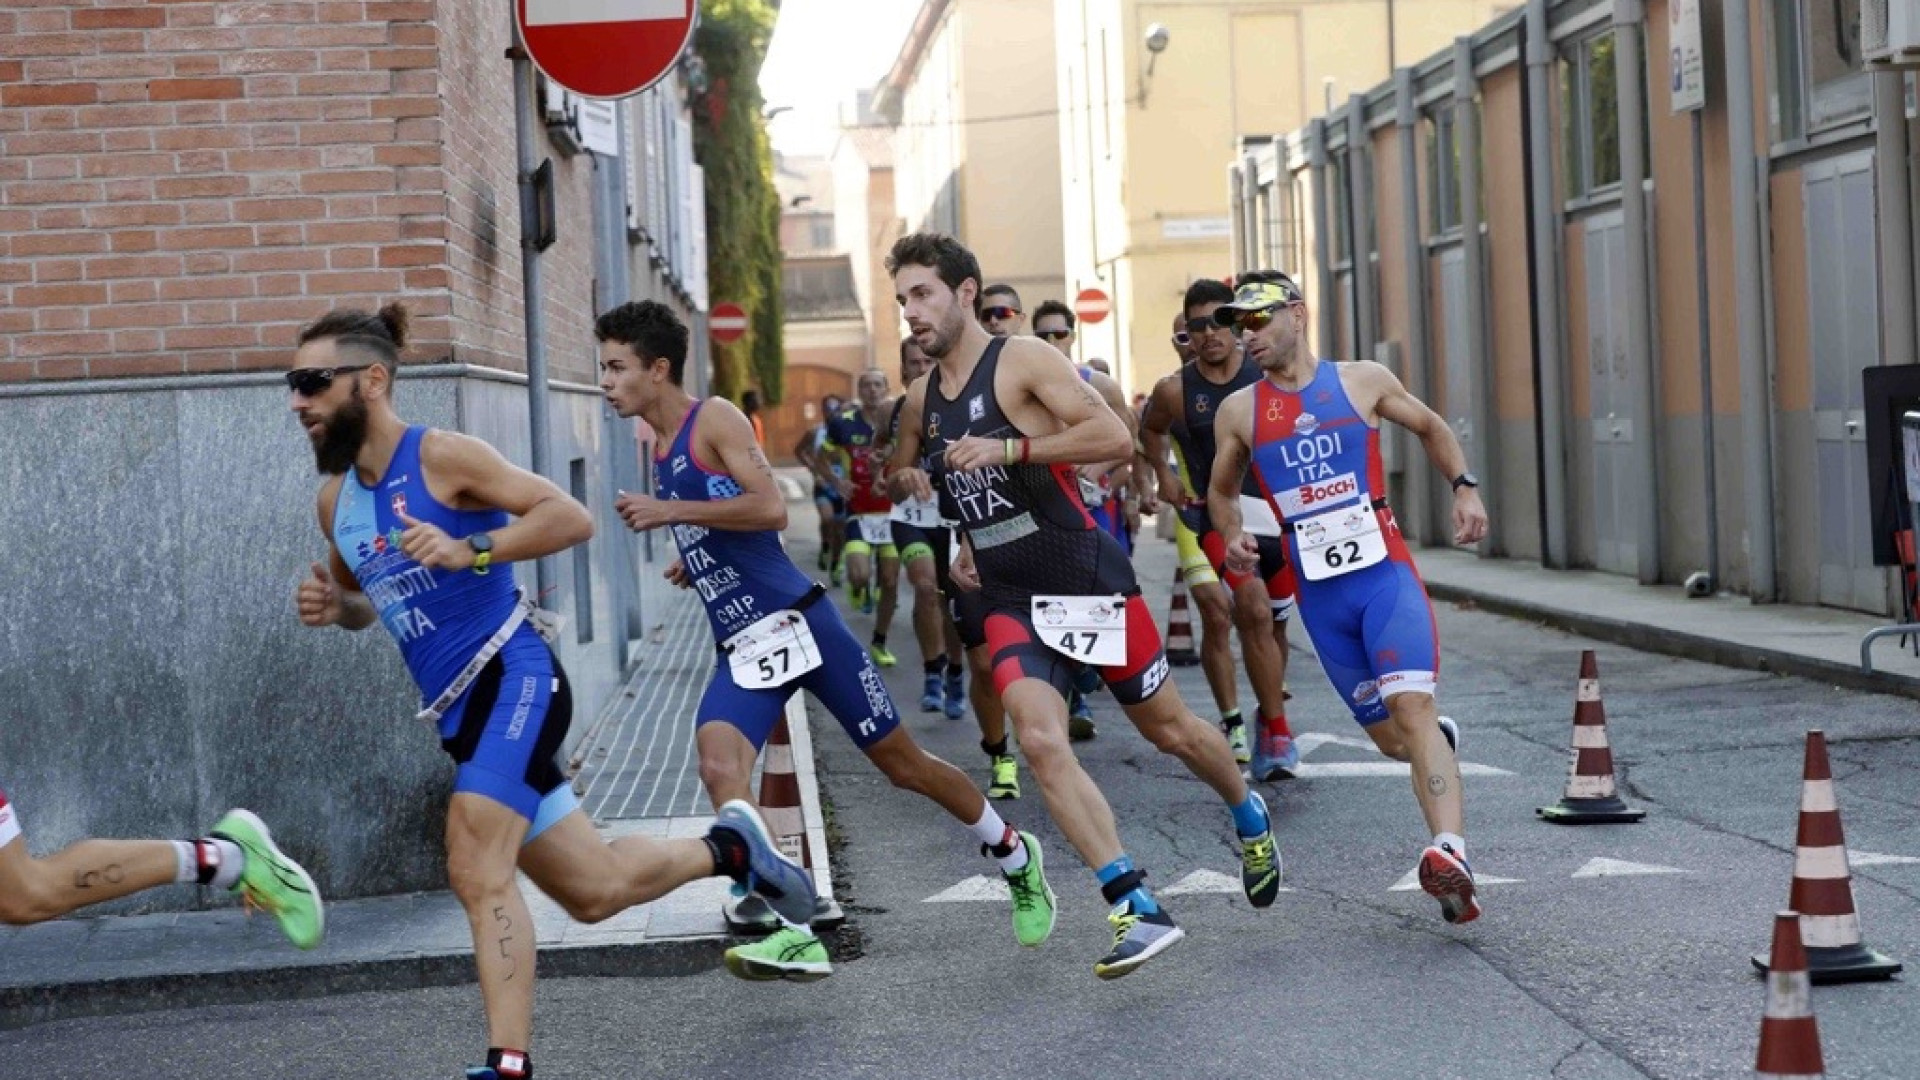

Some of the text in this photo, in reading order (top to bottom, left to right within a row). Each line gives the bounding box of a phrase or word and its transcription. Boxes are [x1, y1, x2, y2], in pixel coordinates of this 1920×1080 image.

[1280, 432, 1342, 468] LODI
[1298, 462, 1335, 483] ITA
[904, 508, 922, 521] 51
[957, 488, 1015, 522] ITA
[685, 547, 717, 575] ITA
[1325, 541, 1363, 568] 62
[391, 607, 437, 643] ITA
[1059, 632, 1099, 655] 47
[758, 647, 790, 681] 57
